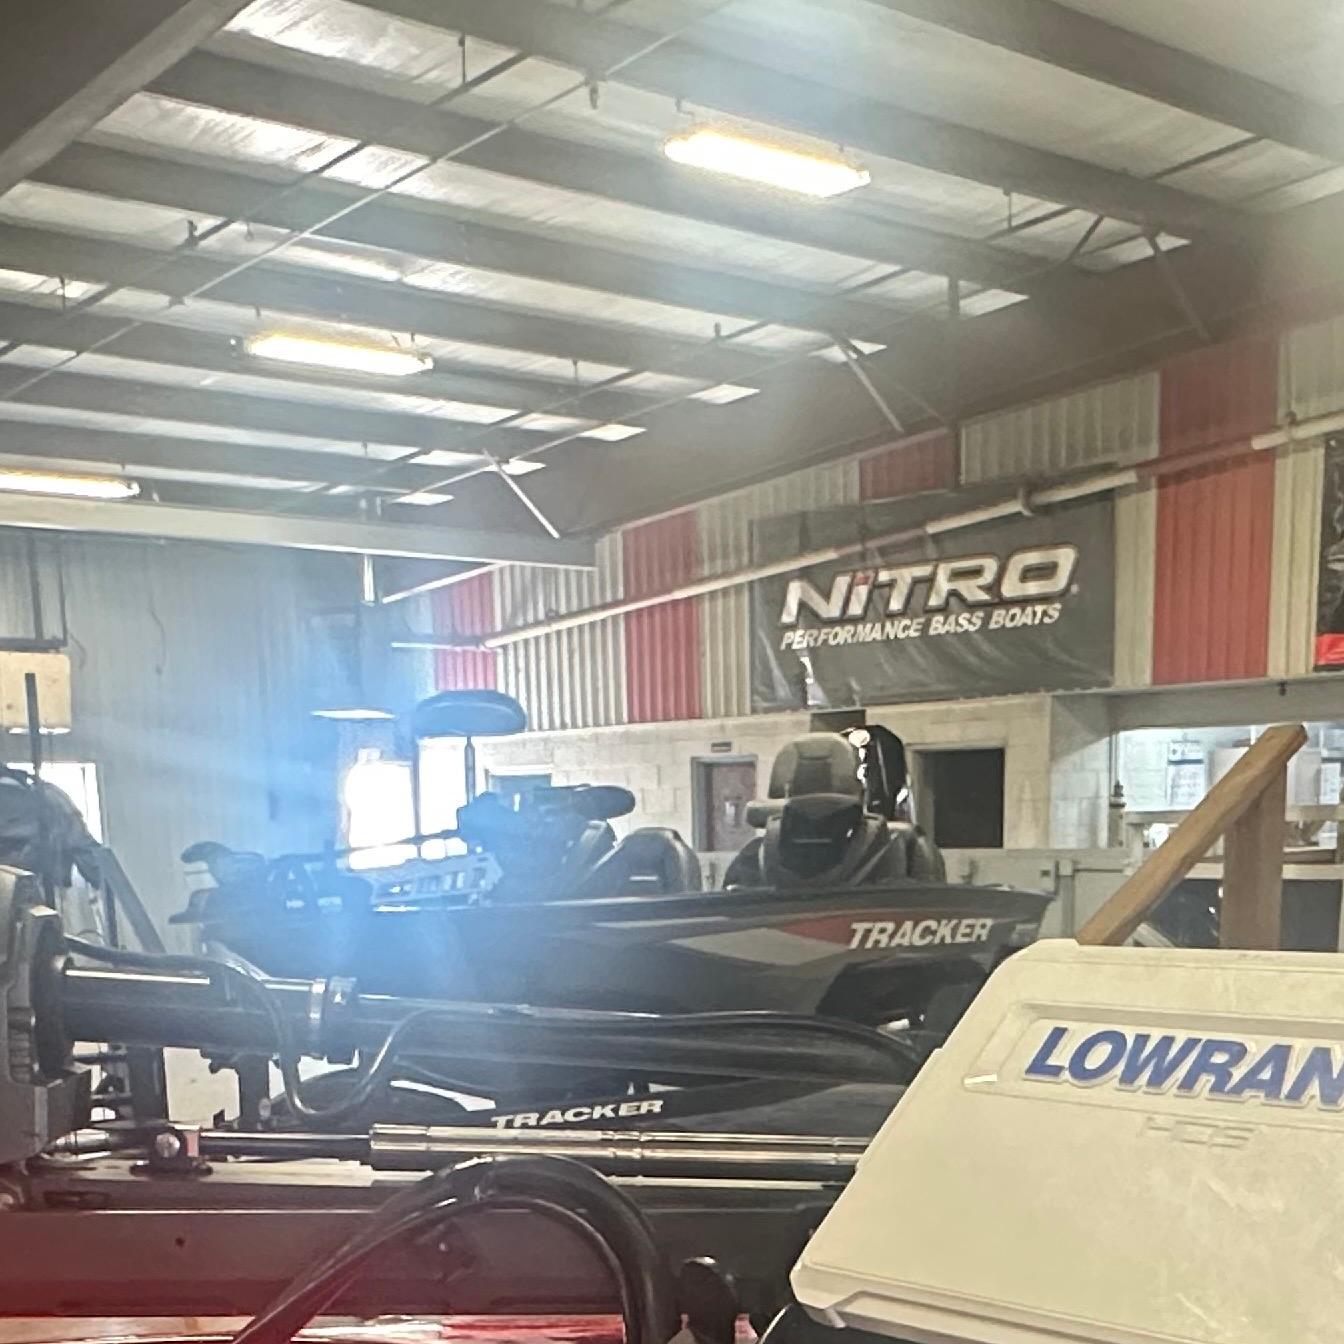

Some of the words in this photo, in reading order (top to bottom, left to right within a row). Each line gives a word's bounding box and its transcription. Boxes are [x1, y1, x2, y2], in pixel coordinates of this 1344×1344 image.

[780, 618, 925, 650] PERFORMANCE
[928, 609, 984, 636] BASS
[988, 602, 1063, 630] BOATS
[849, 918, 993, 949] TRACKER
[490, 1100, 664, 1129] TRACKER
